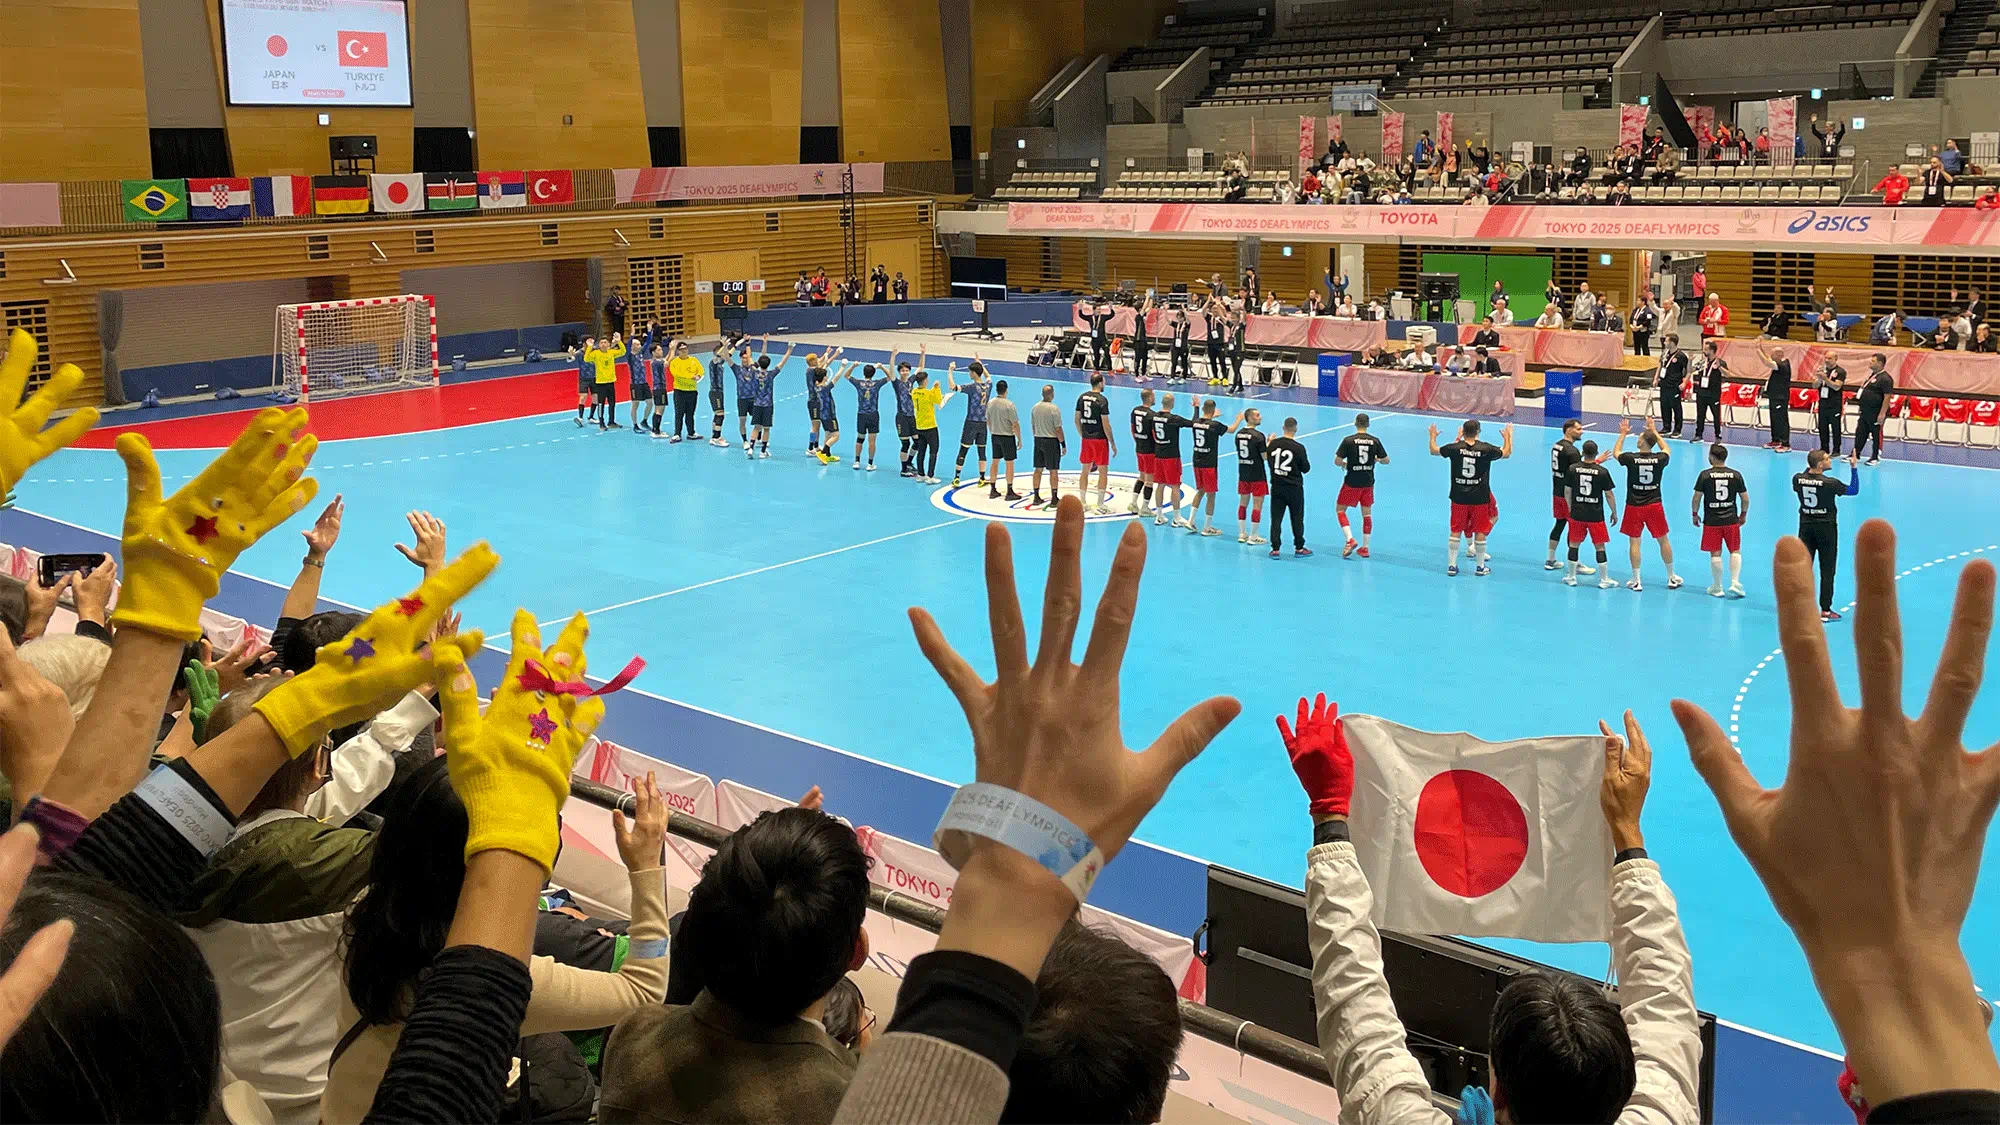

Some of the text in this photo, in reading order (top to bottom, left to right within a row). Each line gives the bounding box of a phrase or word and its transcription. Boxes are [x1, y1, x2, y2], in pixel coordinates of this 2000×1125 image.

[263, 71, 295, 79] JAPAN
[271, 81, 289, 90] 日本
[355, 83, 376, 91] トルコ
[684, 182, 799, 196] TOKYO 2025 DEAFLYMPICS
[1041, 206, 1083, 214] TOKYO 2025
[1379, 212, 1438, 225] TOYOTA
[1046, 215, 1095, 223] DEAFLYMPICS
[1201, 218, 1330, 230] TOKYO 2025 DEAFLYMPICS
[1545, 222, 1721, 236] TOKYO 2025 DEAFLYMPICS
[723, 282, 743, 291] 0:00
[724, 294, 744, 304] 0 0
[1084, 401, 1092, 418] 5
[1135, 416, 1143, 433] 5
[1154, 423, 1165, 440] 5
[1195, 429, 1205, 447] 5
[1239, 440, 1249, 458] 5
[1358, 445, 1369, 465] 5
[1271, 448, 1293, 471] 12
[1462, 457, 1476, 478] 5
[1552, 450, 1559, 470] 5
[1639, 465, 1654, 485] 5
[1580, 474, 1593, 496] 5
[1715, 479, 1729, 501] 5
[1802, 486, 1818, 508] 5
[666, 792, 695, 815] 2025
[181, 815, 204, 838] 2025
[977, 793, 1081, 849] DEAFLYMPICS
[885, 864, 940, 899] TOKYO
